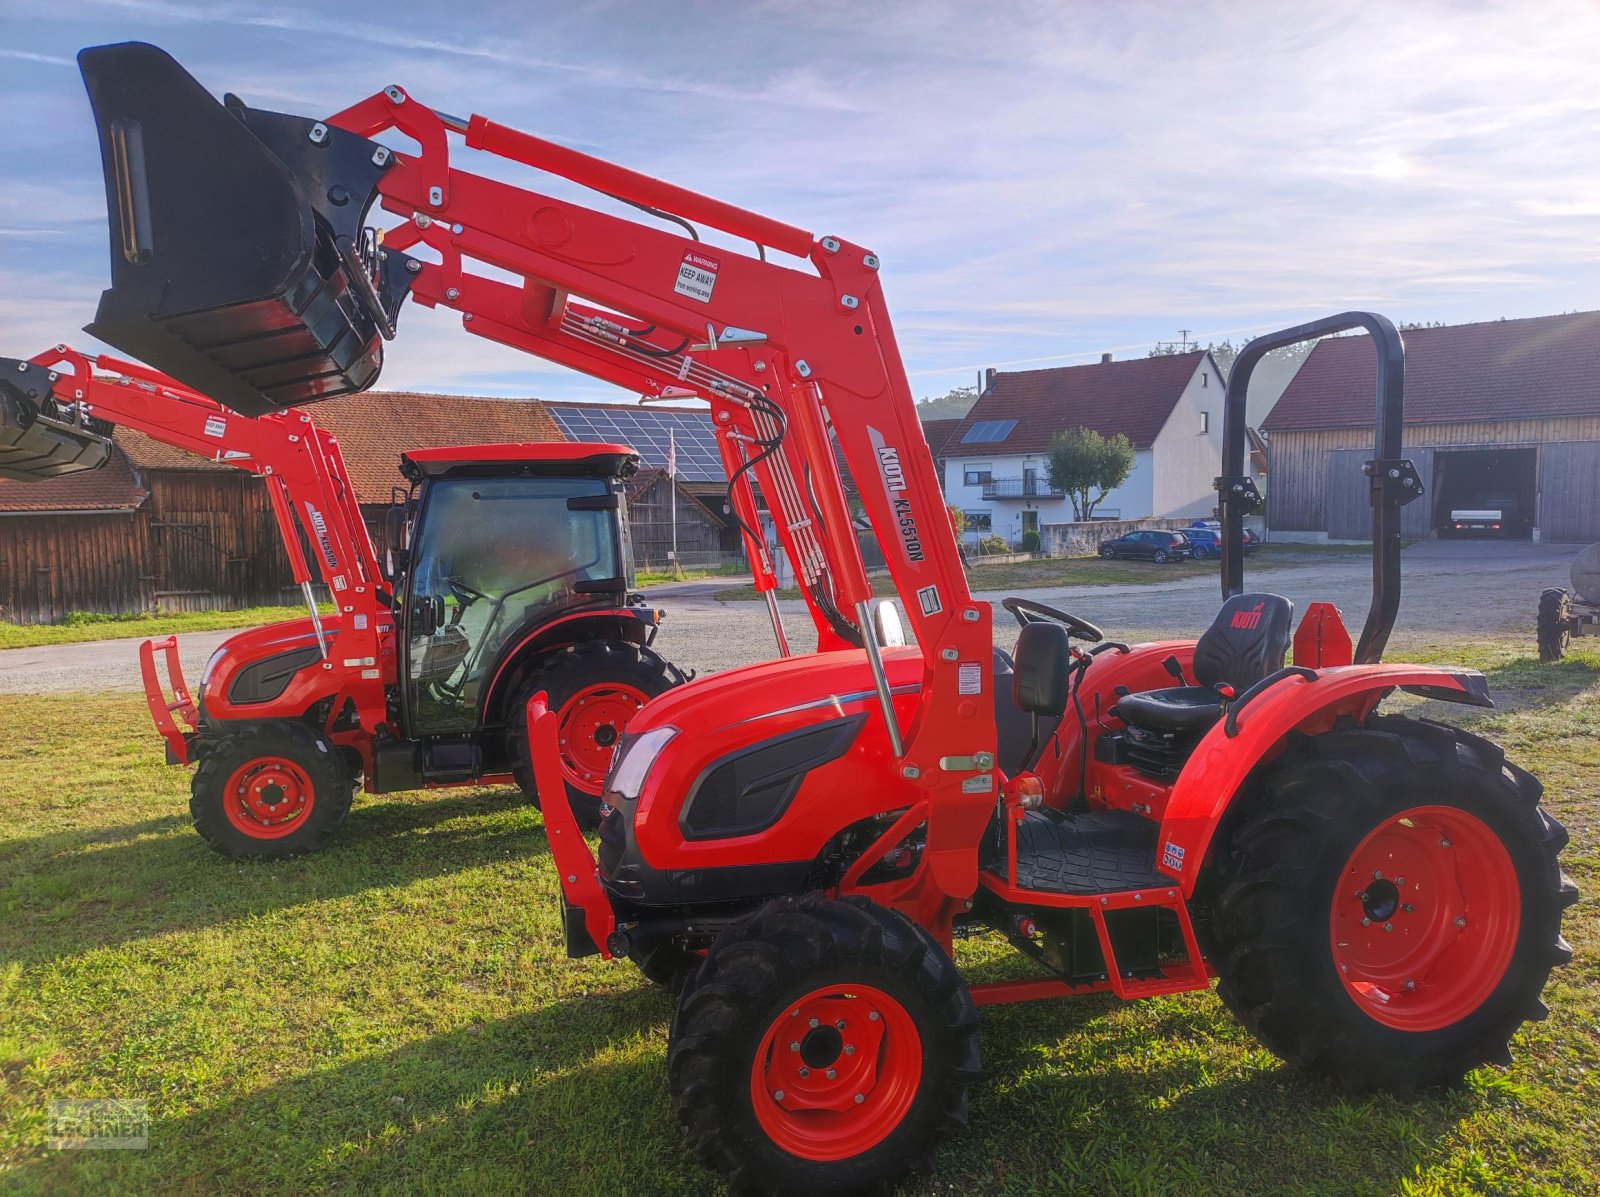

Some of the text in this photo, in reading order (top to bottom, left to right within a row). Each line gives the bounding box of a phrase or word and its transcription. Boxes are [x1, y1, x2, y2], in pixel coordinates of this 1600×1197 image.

[693, 255, 718, 270] WARNING
[680, 266, 714, 287] KEEP AWAY
[686, 285, 701, 296] working
[700, 290, 710, 298] area
[893, 499, 925, 562] KL5510N
